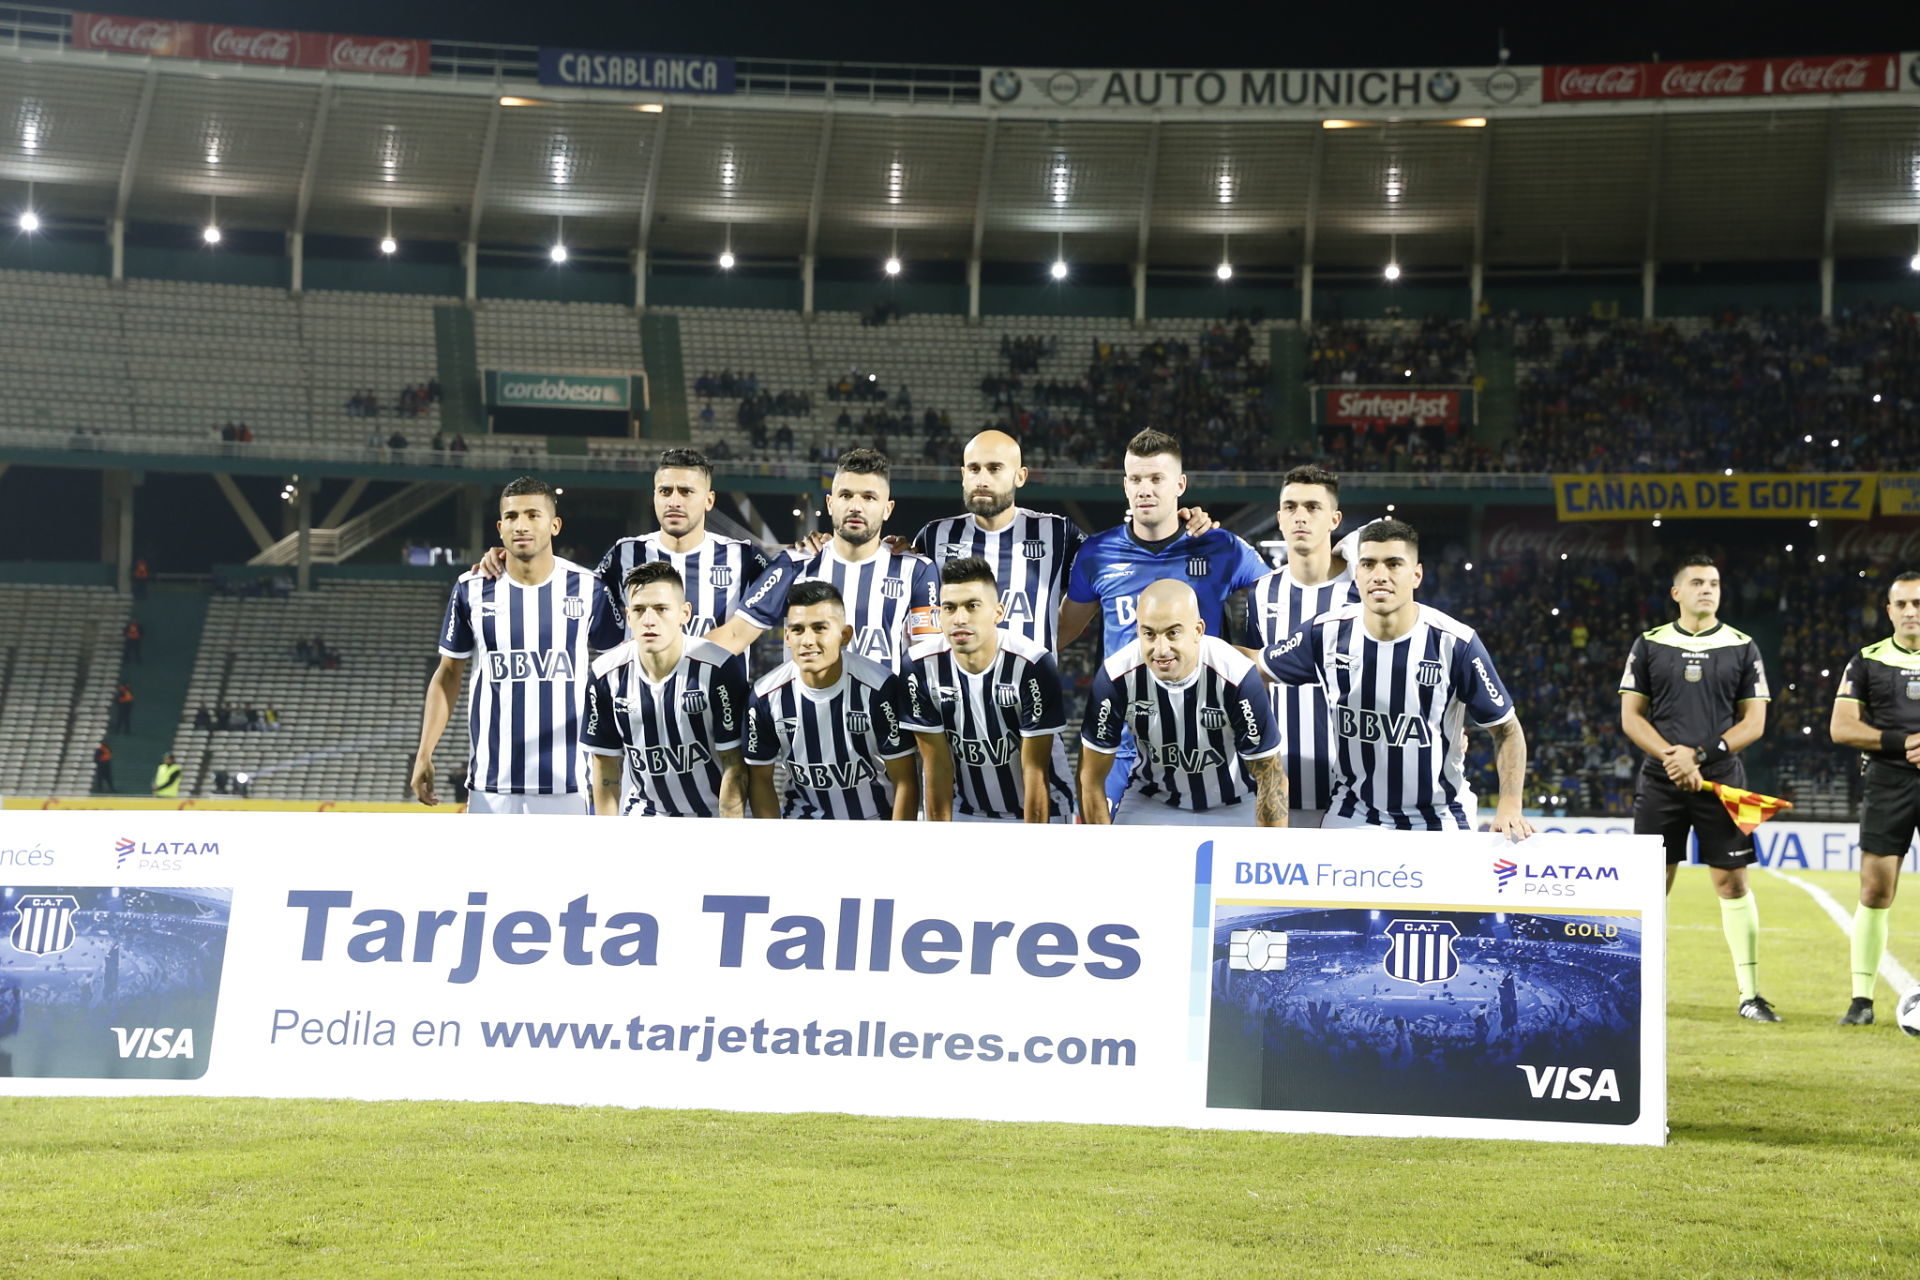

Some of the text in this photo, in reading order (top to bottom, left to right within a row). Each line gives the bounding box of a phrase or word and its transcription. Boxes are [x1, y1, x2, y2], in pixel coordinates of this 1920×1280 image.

[91, 18, 173, 50] Coca-Cola
[212, 29, 292, 60] Coca-Cola
[332, 38, 409, 69] Coca-Cola
[558, 53, 718, 90] CASABLANCA
[1560, 68, 1639, 95] Coca-Cola
[1661, 63, 1749, 95] Coca-Cola
[1781, 58, 1871, 90] Coca-Cola
[1102, 72, 1421, 105] AUTO MUNICH
[503, 378, 602, 402] cordobesa
[1337, 392, 1450, 423] Sinteplast
[1695, 480, 1740, 509] DE
[1750, 479, 1863, 510] GOMEZ
[744, 574, 777, 608] PROACO
[488, 650, 575, 682] BBVA
[1472, 656, 1499, 698] PROACO
[716, 684, 732, 722] PROACO
[1028, 678, 1043, 717] PROACO
[880, 701, 898, 737] PROACO
[1239, 698, 1258, 736] PROACO
[1337, 704, 1432, 748] BBVA
[623, 741, 712, 776] BBVA
[787, 757, 877, 790] BBVA
[141, 842, 220, 855] LATAM
[138, 859, 183, 871] PASS
[1235, 862, 1424, 888] BBVA Francés
[1525, 864, 1619, 880] LATAM
[1524, 883, 1576, 897] PASS
[286, 890, 1142, 984] Tarjeta Talleres
[1564, 923, 1618, 938] GOLD
[111, 1027, 194, 1059] VISA
[270, 1009, 1137, 1067] Pedila en www.tarjetatalleres.com
[1517, 1064, 1621, 1102] VISA
